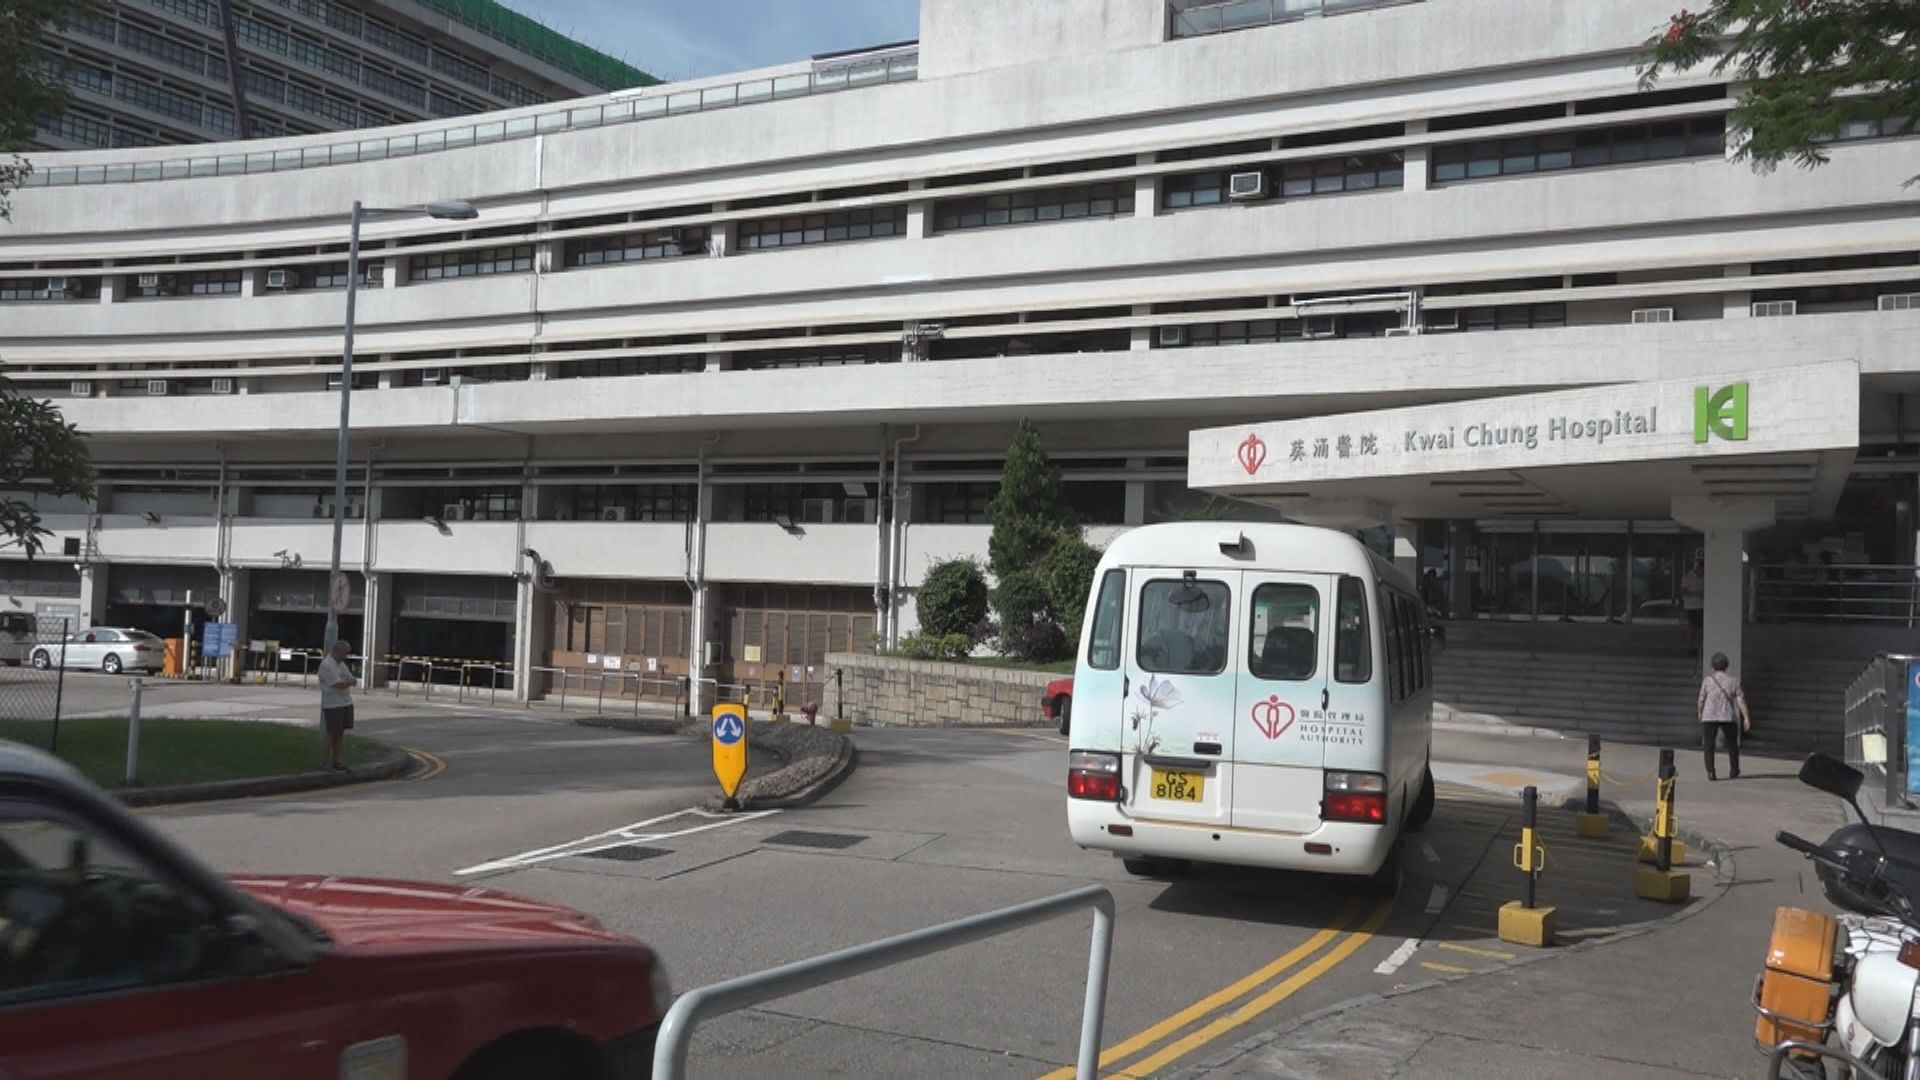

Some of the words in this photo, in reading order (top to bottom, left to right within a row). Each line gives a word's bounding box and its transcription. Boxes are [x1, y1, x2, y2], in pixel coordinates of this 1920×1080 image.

[1403, 426, 1455, 452] Kwai
[1463, 422, 1539, 449] Chung
[1548, 406, 1658, 444] Hospital
[1300, 724, 1363, 737] HOSPITAL
[1299, 734, 1363, 746] AUTHORITY
[1165, 771, 1188, 786] GS
[1156, 784, 1196, 801] 8184
